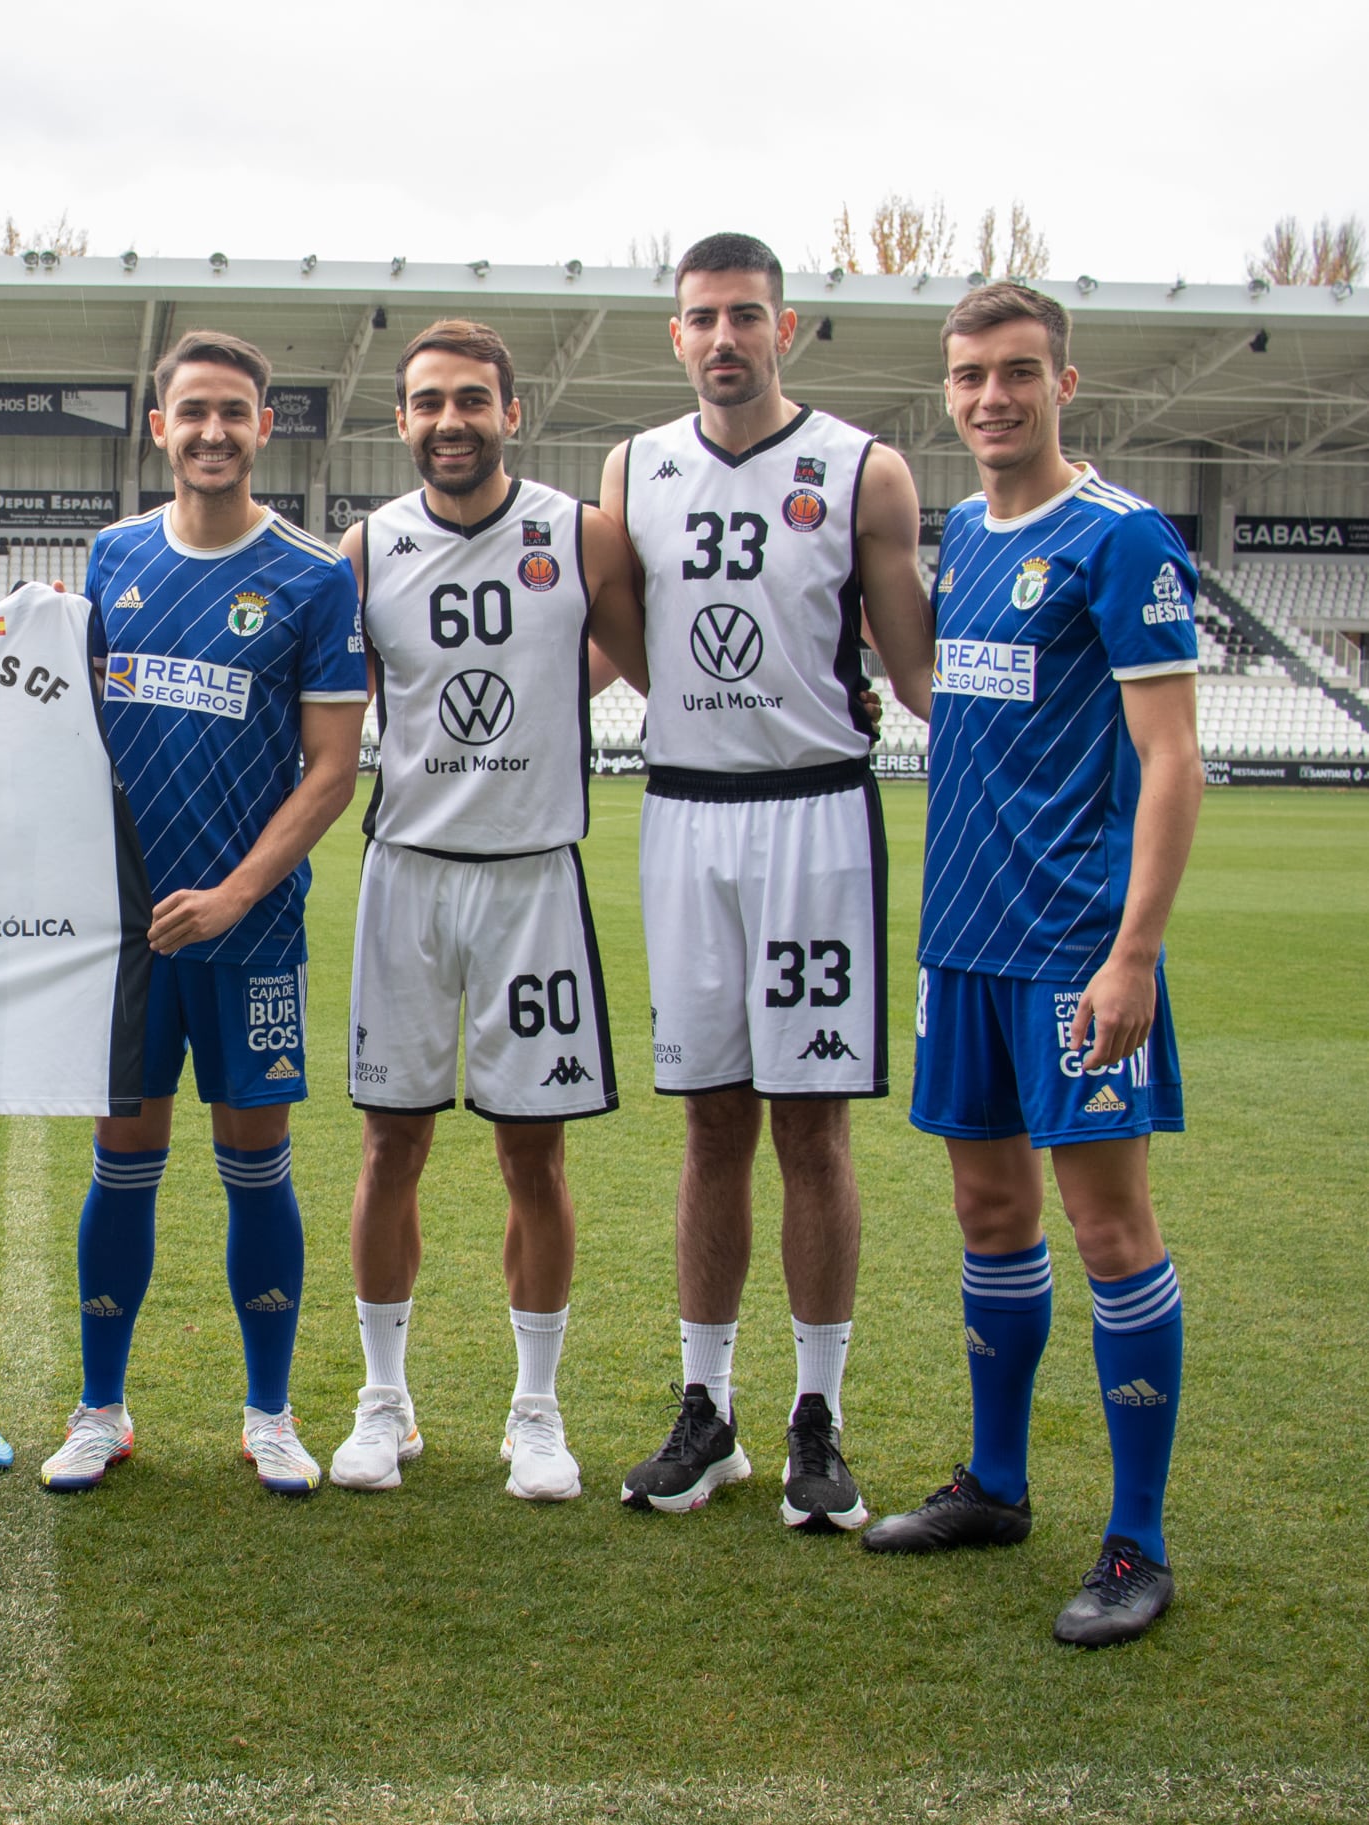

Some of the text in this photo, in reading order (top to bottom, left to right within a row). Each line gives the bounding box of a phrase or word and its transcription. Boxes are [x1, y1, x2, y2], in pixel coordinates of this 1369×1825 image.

[27, 394, 54, 412] BK
[51, 495, 114, 510] ESPAÑA
[682, 511, 769, 581] 33
[1234, 524, 1343, 546] GABASA
[116, 599, 144, 609] adidas
[430, 580, 513, 648] 60
[947, 643, 1032, 674] REALE
[24, 666, 69, 704] CF
[144, 659, 248, 695] REALE
[946, 672, 1031, 696] SEGUROS
[142, 684, 243, 715] SEGUROS
[683, 692, 783, 711] Ural Motor
[425, 755, 530, 774] Ural Motor
[1232, 768, 1286, 778] RESTAURANTE
[249, 973, 294, 985] FUNDACIÓN
[766, 940, 851, 1008] 33
[249, 984, 295, 1001] CAJA DE
[508, 969, 580, 1038] 60
[249, 999, 297, 1026] BUR
[248, 1025, 299, 1051] GOS
[265, 1069, 300, 1080] adidas
[1084, 1102, 1127, 1113] adidas
